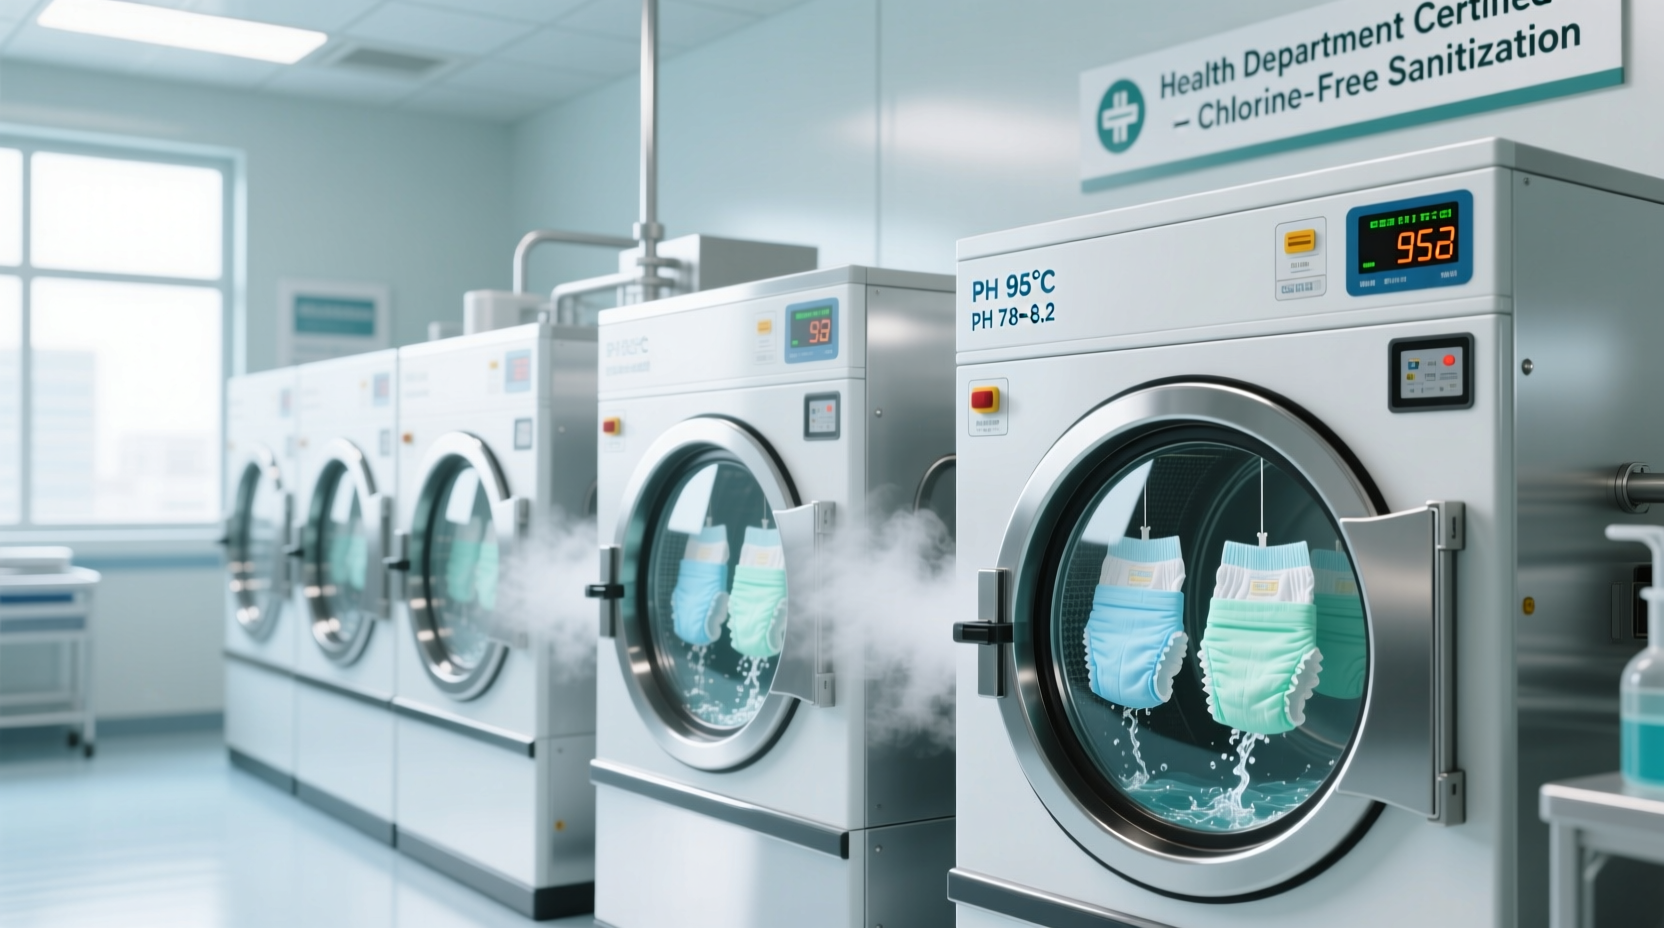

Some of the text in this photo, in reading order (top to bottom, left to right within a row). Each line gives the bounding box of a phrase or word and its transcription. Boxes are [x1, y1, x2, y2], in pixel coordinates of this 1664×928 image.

[1160, 0, 1552, 100] Health Department Certi
[1197, 68, 1380, 130] Chlorine-Free
[1388, 22, 1582, 88] Sanitization
[972, 269, 1056, 303] PH 95°C
[972, 309, 993, 331] PH
